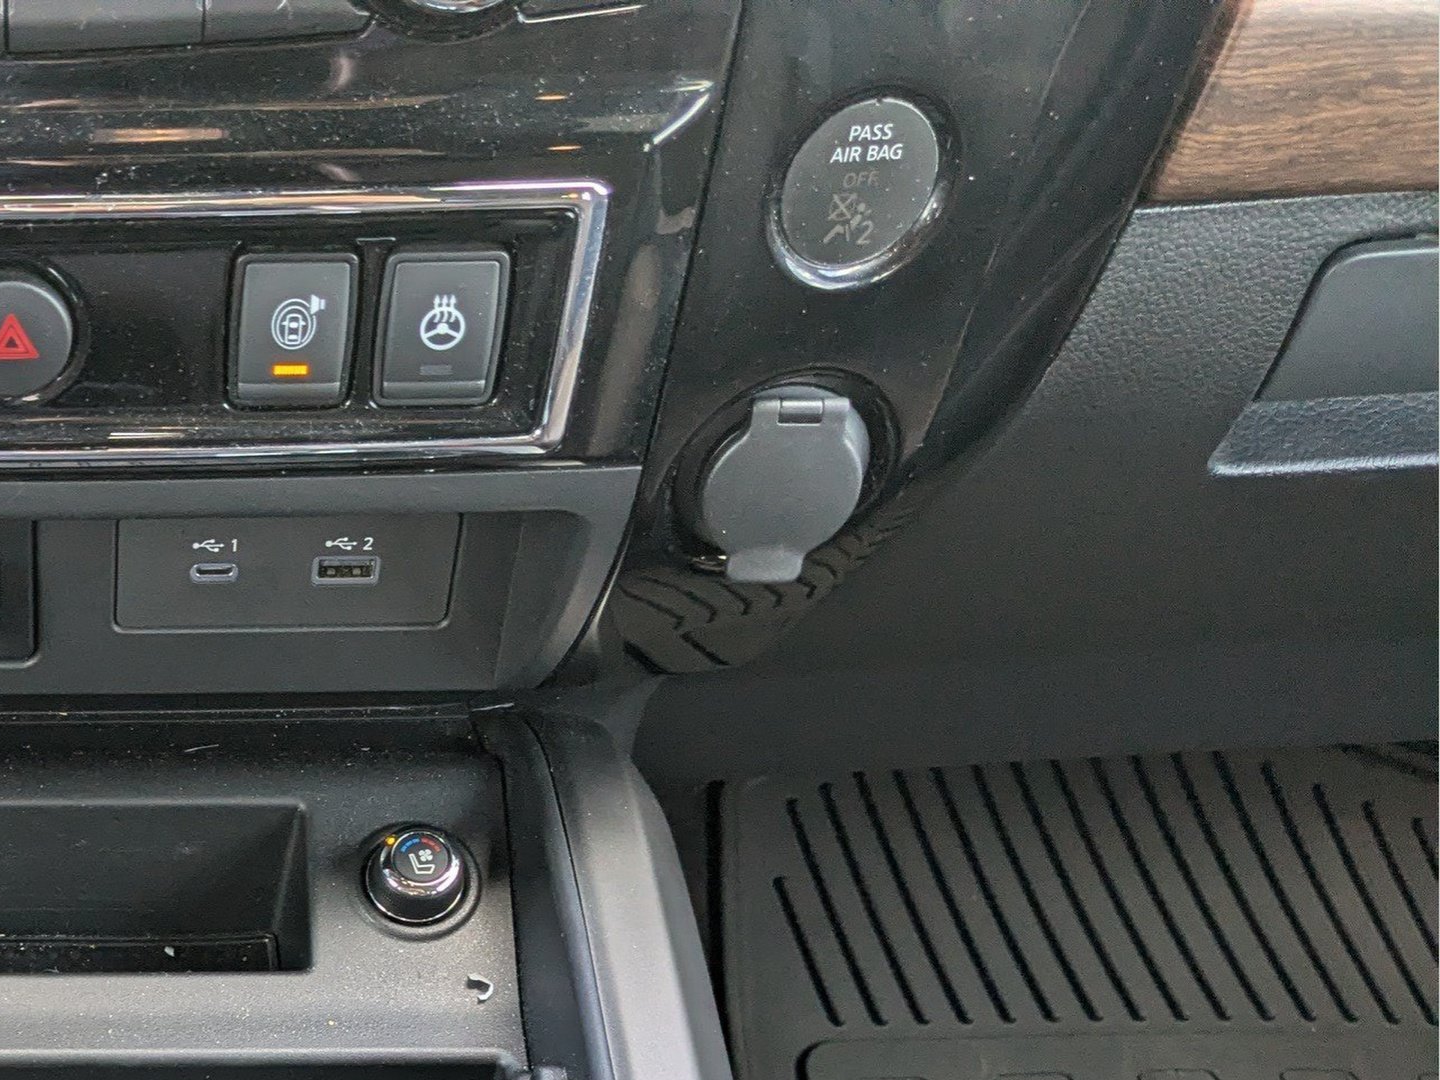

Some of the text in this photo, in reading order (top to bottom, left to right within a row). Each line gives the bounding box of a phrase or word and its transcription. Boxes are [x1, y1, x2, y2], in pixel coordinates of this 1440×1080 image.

[848, 124, 893, 141] PASS
[829, 143, 903, 163] AIR BAG
